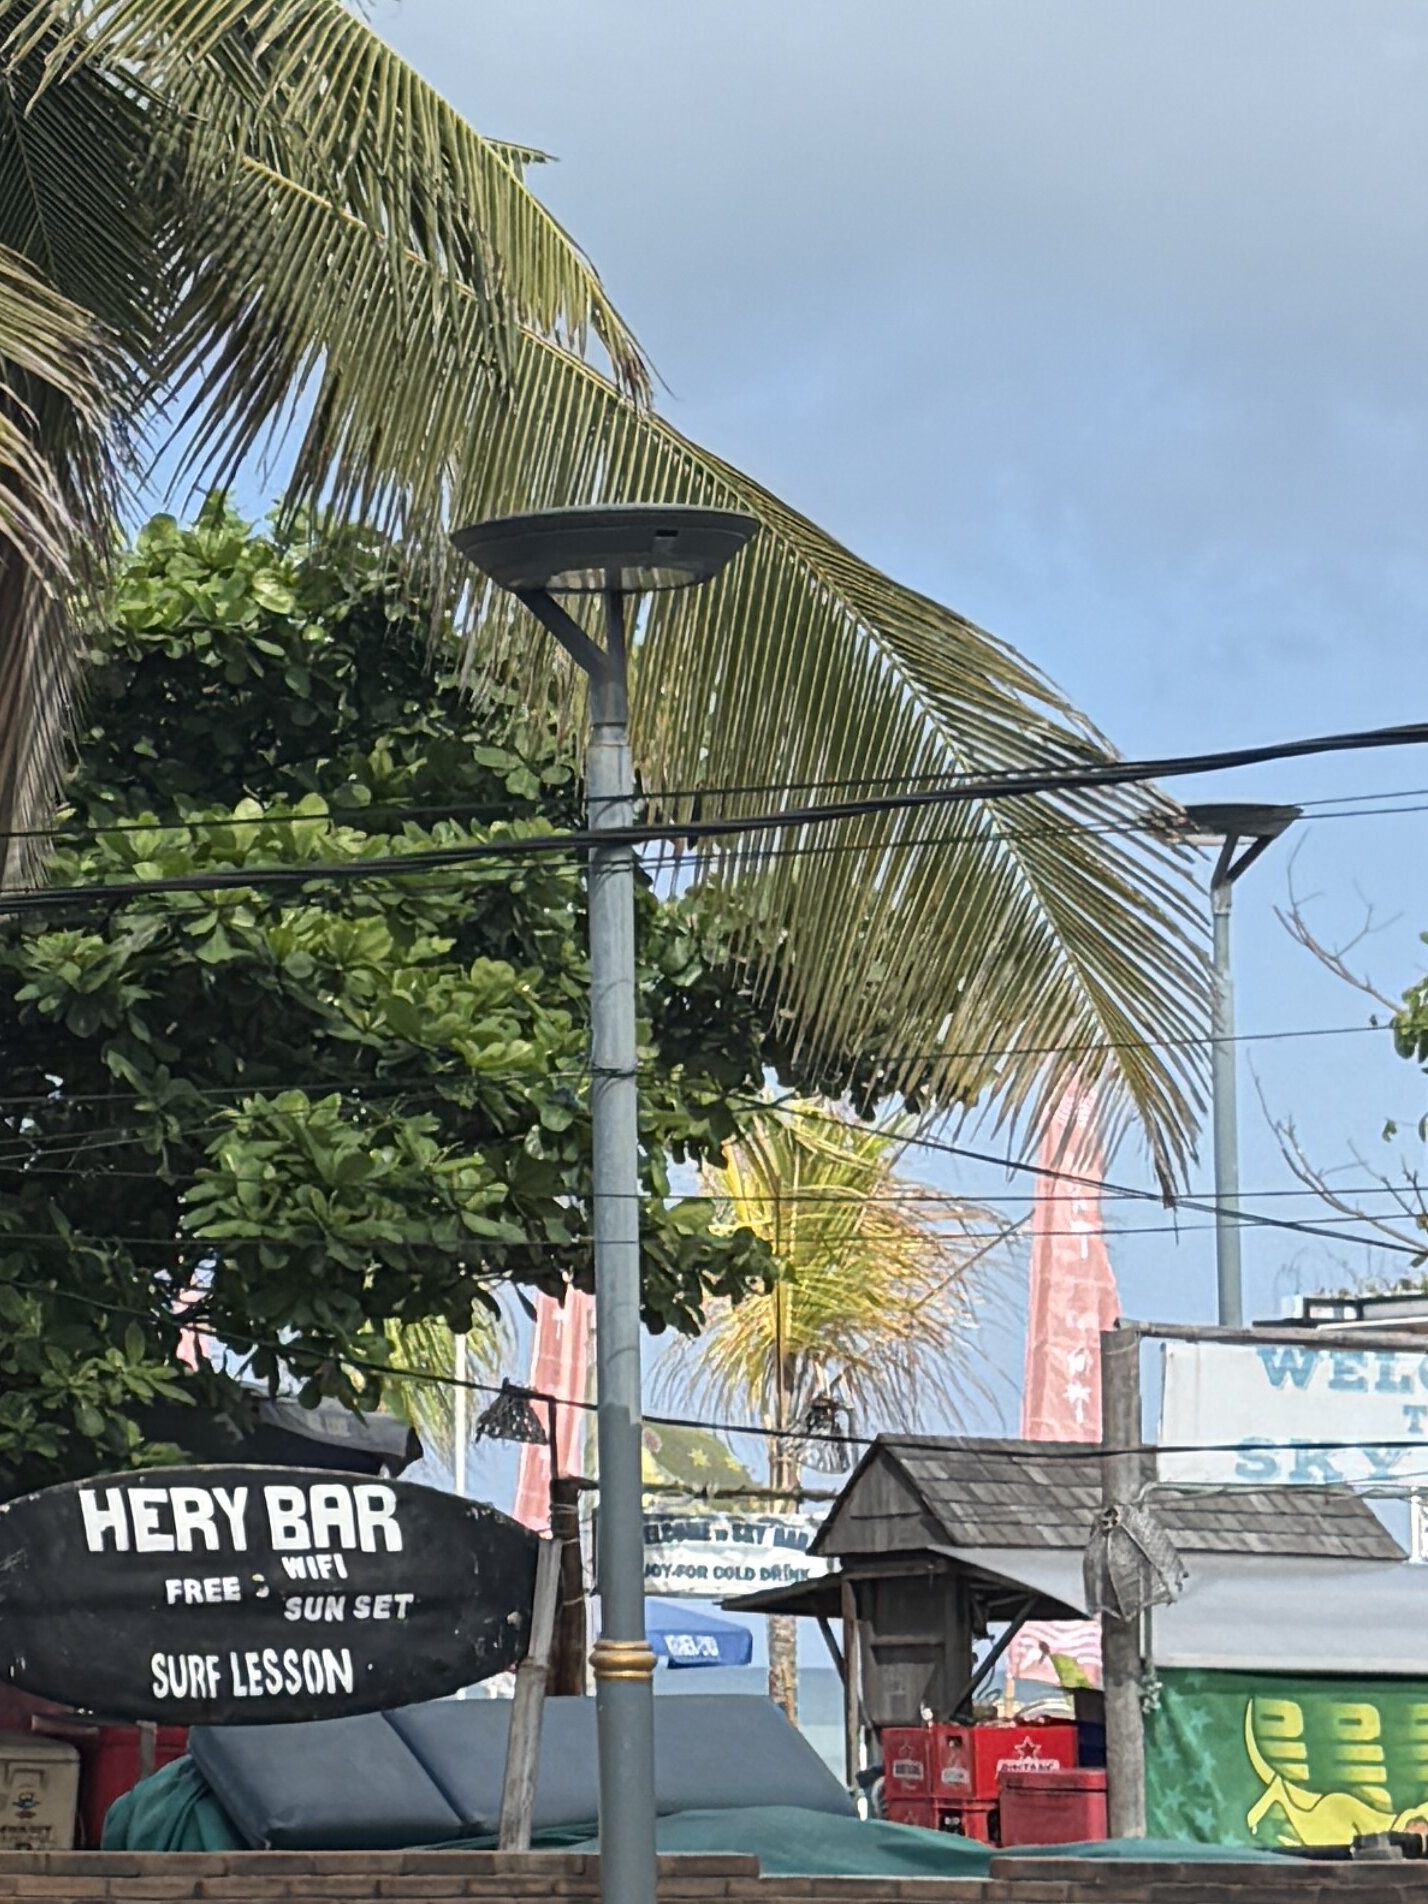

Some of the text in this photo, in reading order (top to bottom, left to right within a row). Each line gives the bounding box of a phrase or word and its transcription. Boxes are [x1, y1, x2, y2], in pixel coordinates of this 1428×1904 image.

[1256, 1346, 1428, 1394] WEL
[79, 1484, 402, 1552] HERY BAR
[165, 1576, 242, 1605] FREE
[281, 1553, 348, 1580] WIFI
[713, 1565, 756, 1581] COLD
[151, 1648, 353, 1699] SURF LESSON
